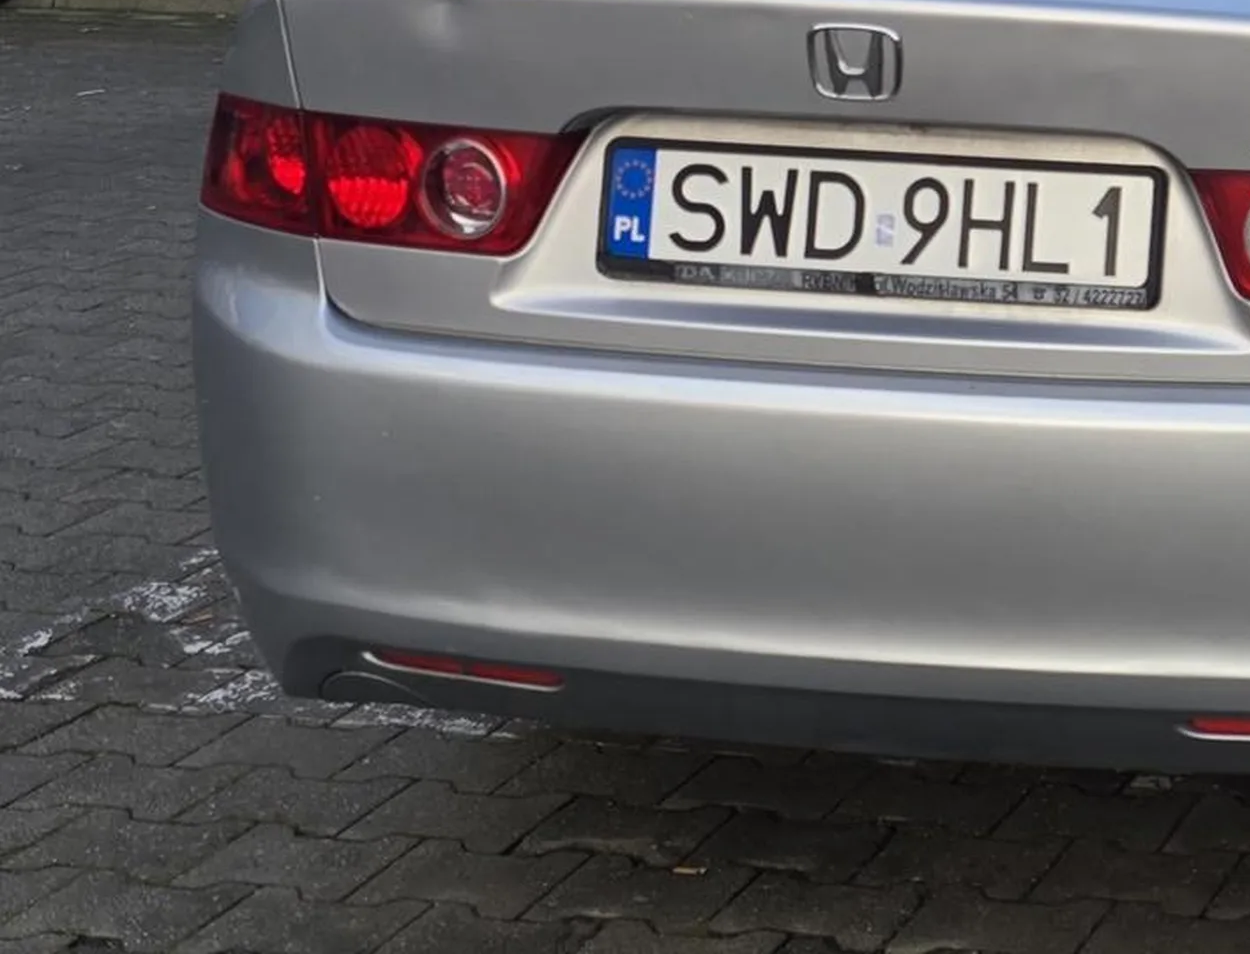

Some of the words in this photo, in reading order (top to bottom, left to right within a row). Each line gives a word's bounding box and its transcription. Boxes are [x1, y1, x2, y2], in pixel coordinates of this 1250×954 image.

[614, 214, 646, 243] PL
[669, 163, 866, 260] SWD
[900, 177, 1123, 277] 9HL1
